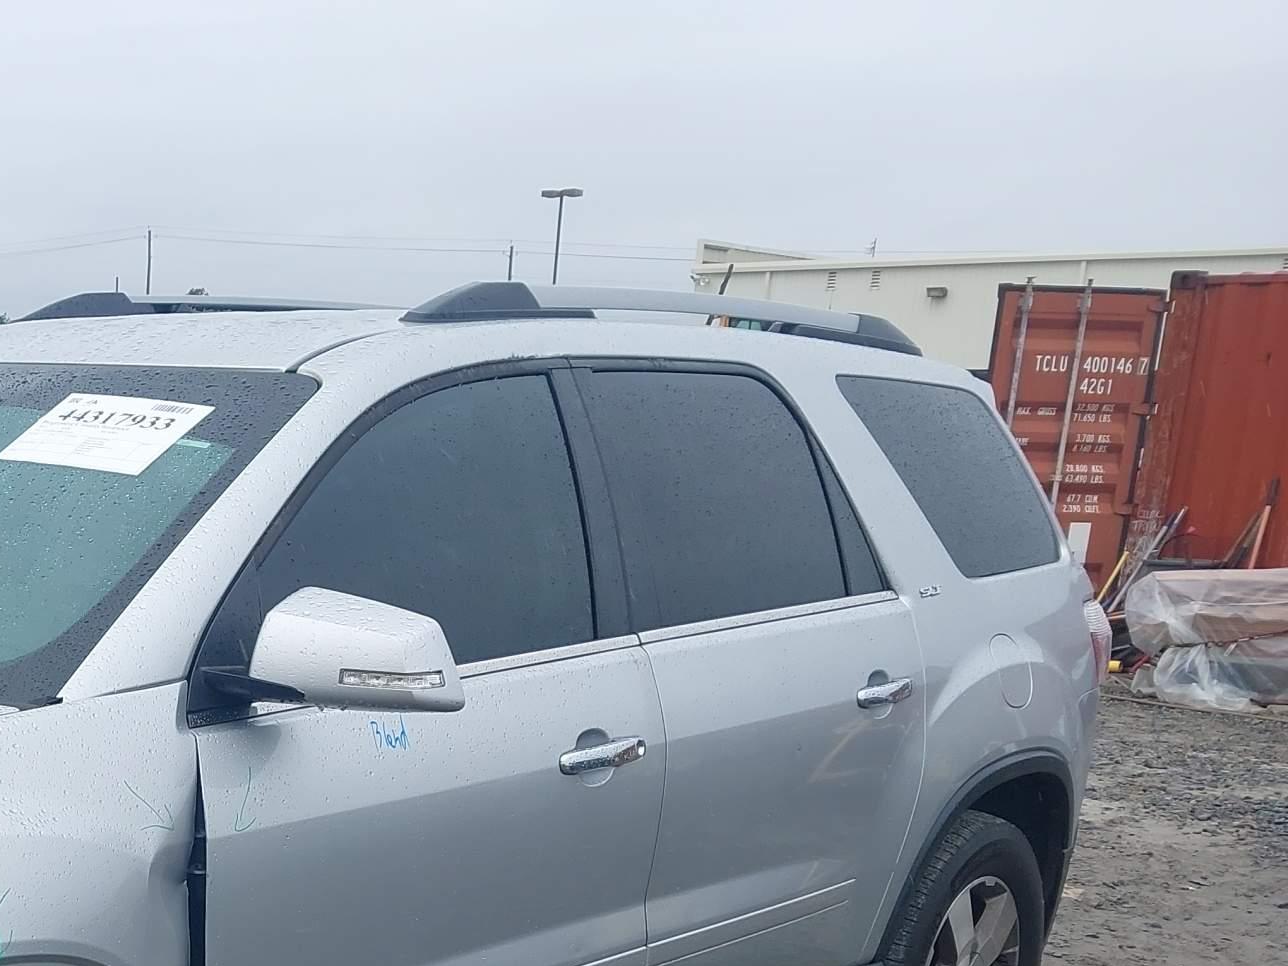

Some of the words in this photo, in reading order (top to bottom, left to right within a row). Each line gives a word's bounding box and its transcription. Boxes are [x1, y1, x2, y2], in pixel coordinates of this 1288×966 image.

[1035, 355, 1069, 372] TCLU
[1083, 356, 1134, 374] 400146
[1139, 358, 1149, 374] 7
[1079, 378, 1113, 395] 42G1
[58, 408, 176, 430] 44317933
